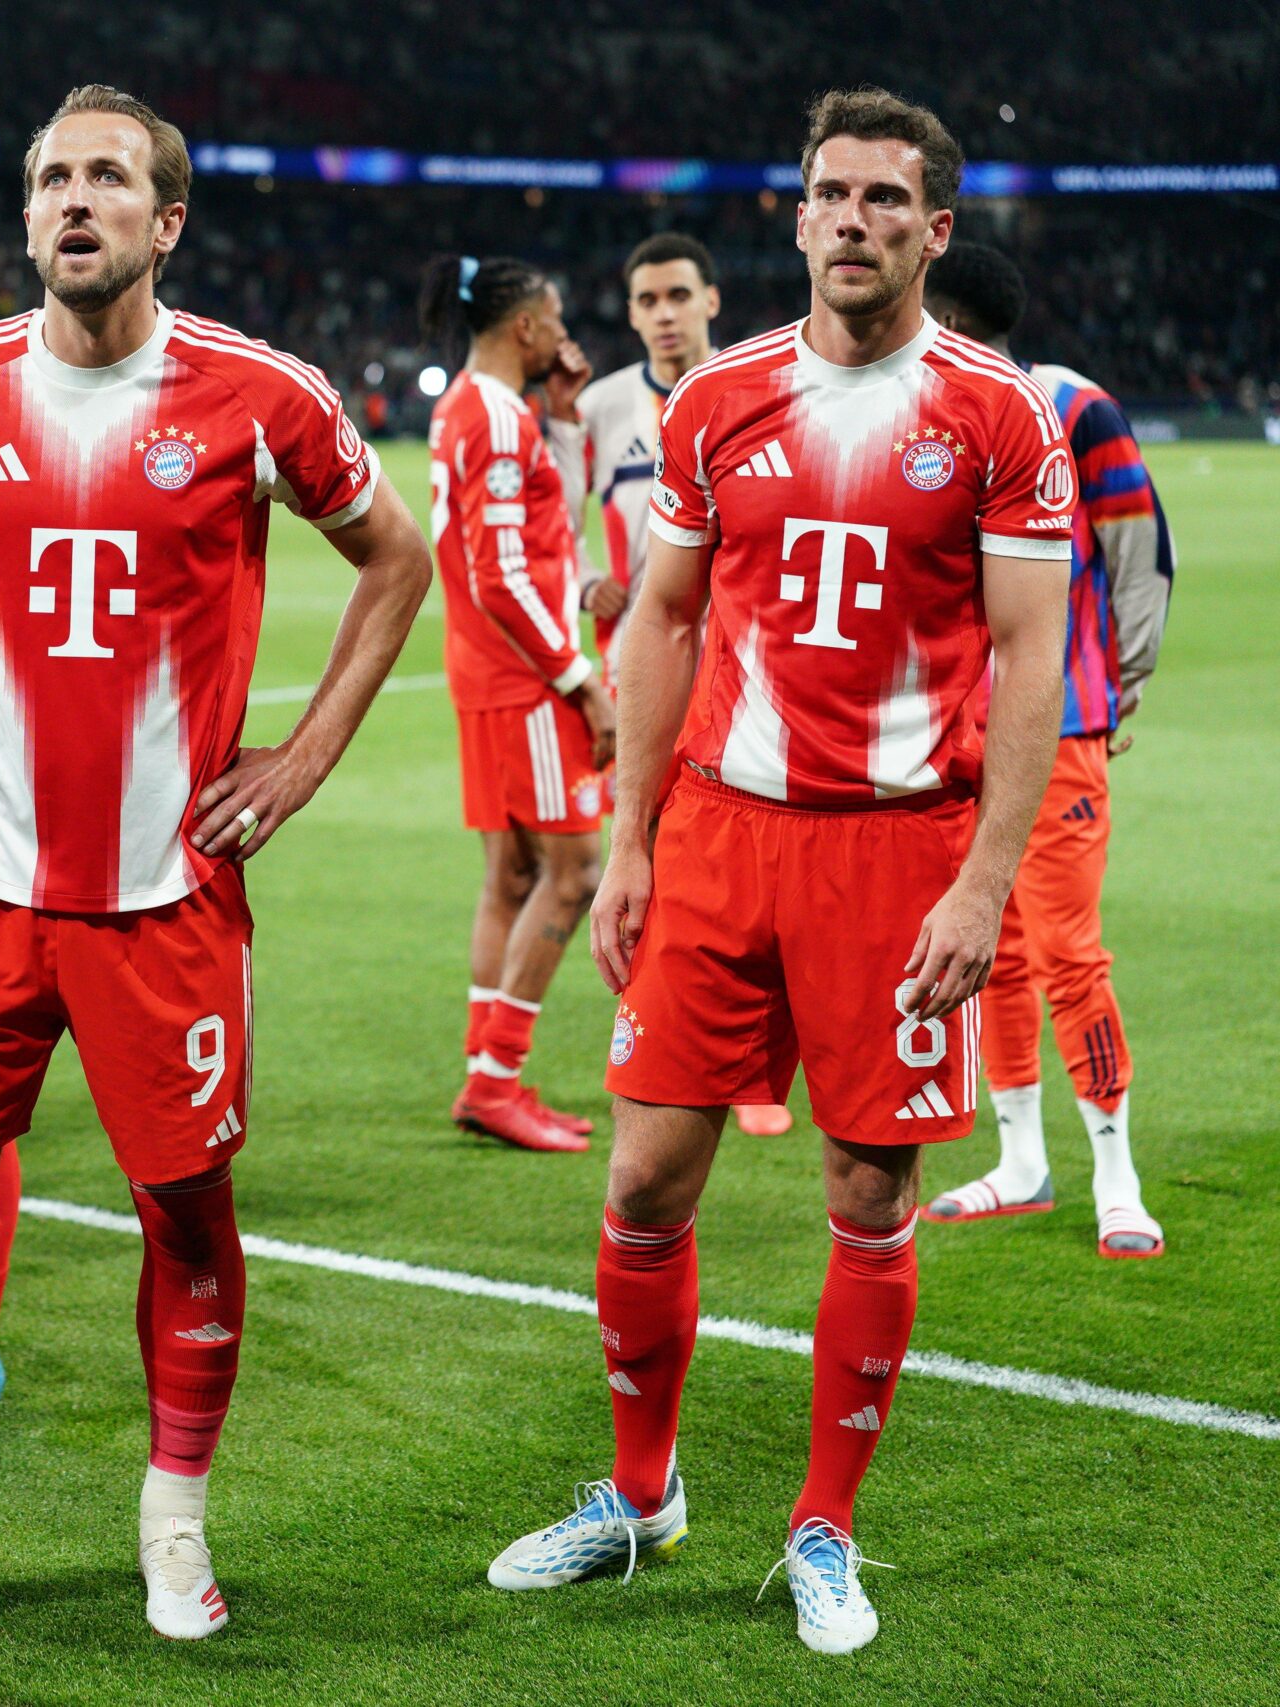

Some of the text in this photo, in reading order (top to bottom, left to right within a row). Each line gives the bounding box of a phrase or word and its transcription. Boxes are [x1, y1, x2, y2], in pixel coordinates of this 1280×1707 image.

[149, 444, 192, 463] FC BAYERN
[907, 445, 950, 463] FC BAYERN
[28, 527, 138, 659] T
[779, 517, 889, 651] T
[185, 1013, 226, 1108] 9
[894, 977, 947, 1069] 8
